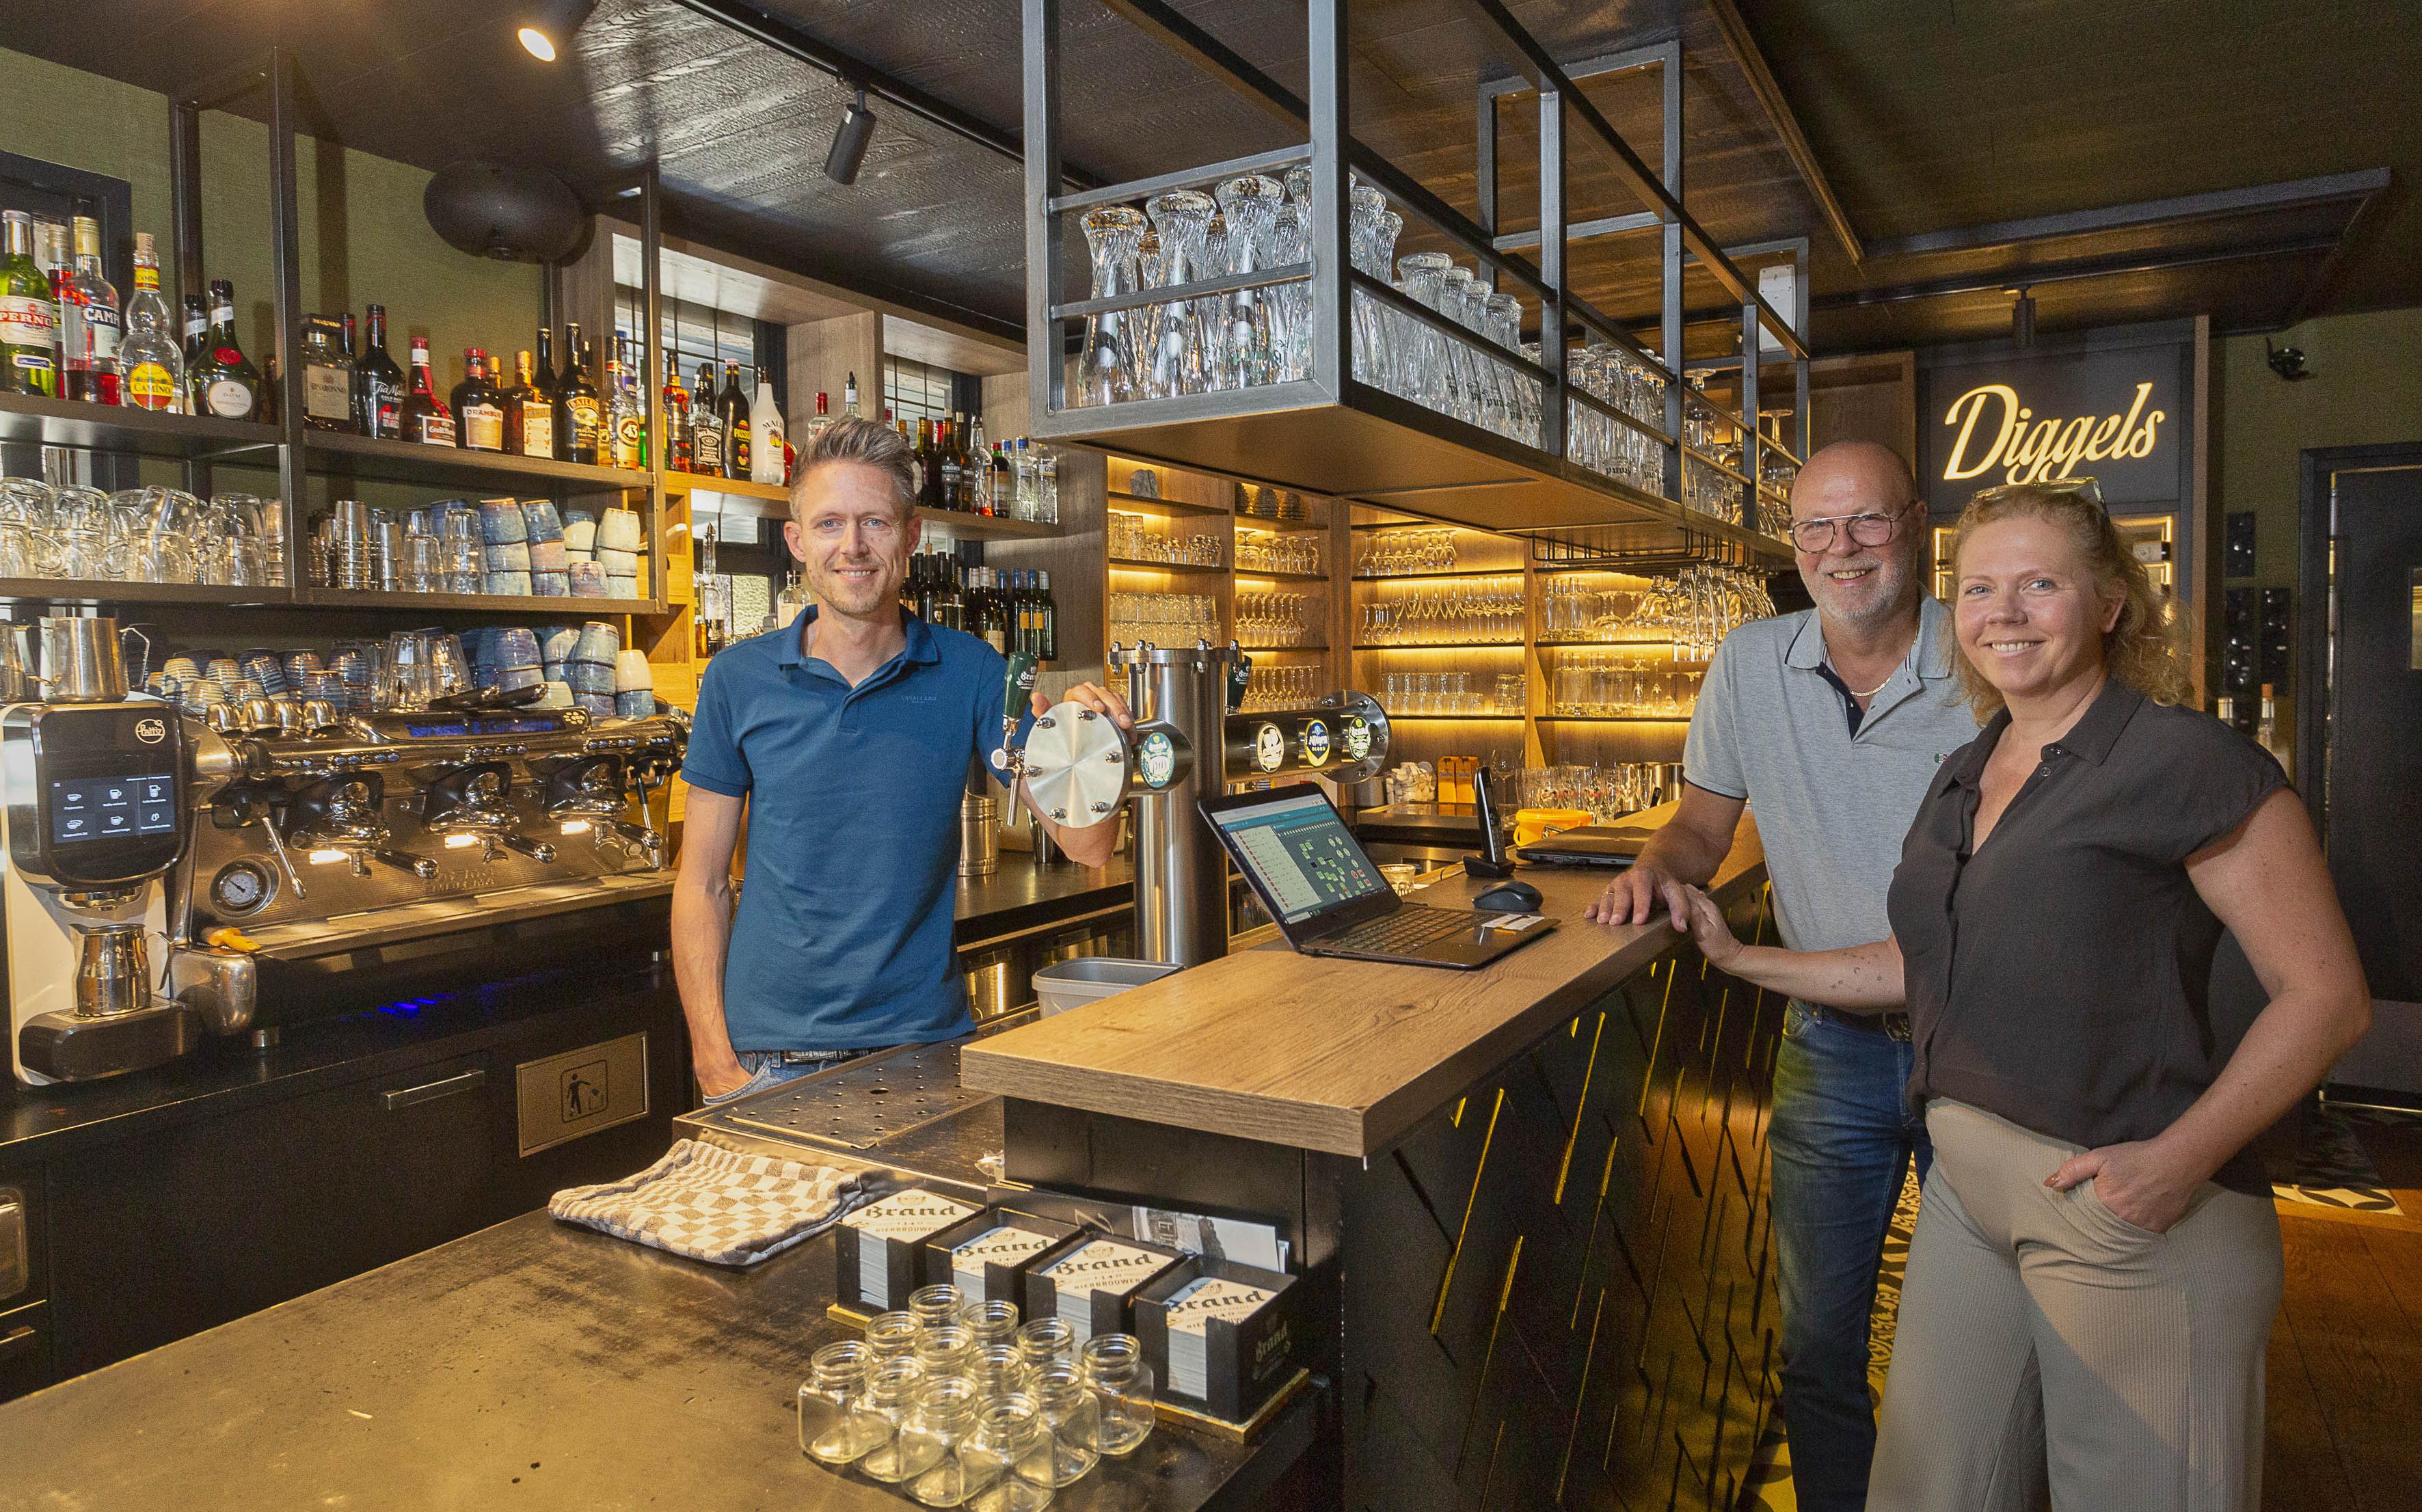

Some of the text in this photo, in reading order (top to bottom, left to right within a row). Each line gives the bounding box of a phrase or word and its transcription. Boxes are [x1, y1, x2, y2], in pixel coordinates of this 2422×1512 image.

[0, 312, 53, 327] PERNO
[83, 308, 120, 326] CAMP
[623, 424, 638, 439] 43
[1943, 382, 2165, 485] Diggels
[865, 1205, 956, 1218] Brand
[957, 1239, 1048, 1258] Brand
[1055, 1254, 1153, 1275] Brand
[1166, 1290, 1265, 1314] Brand
